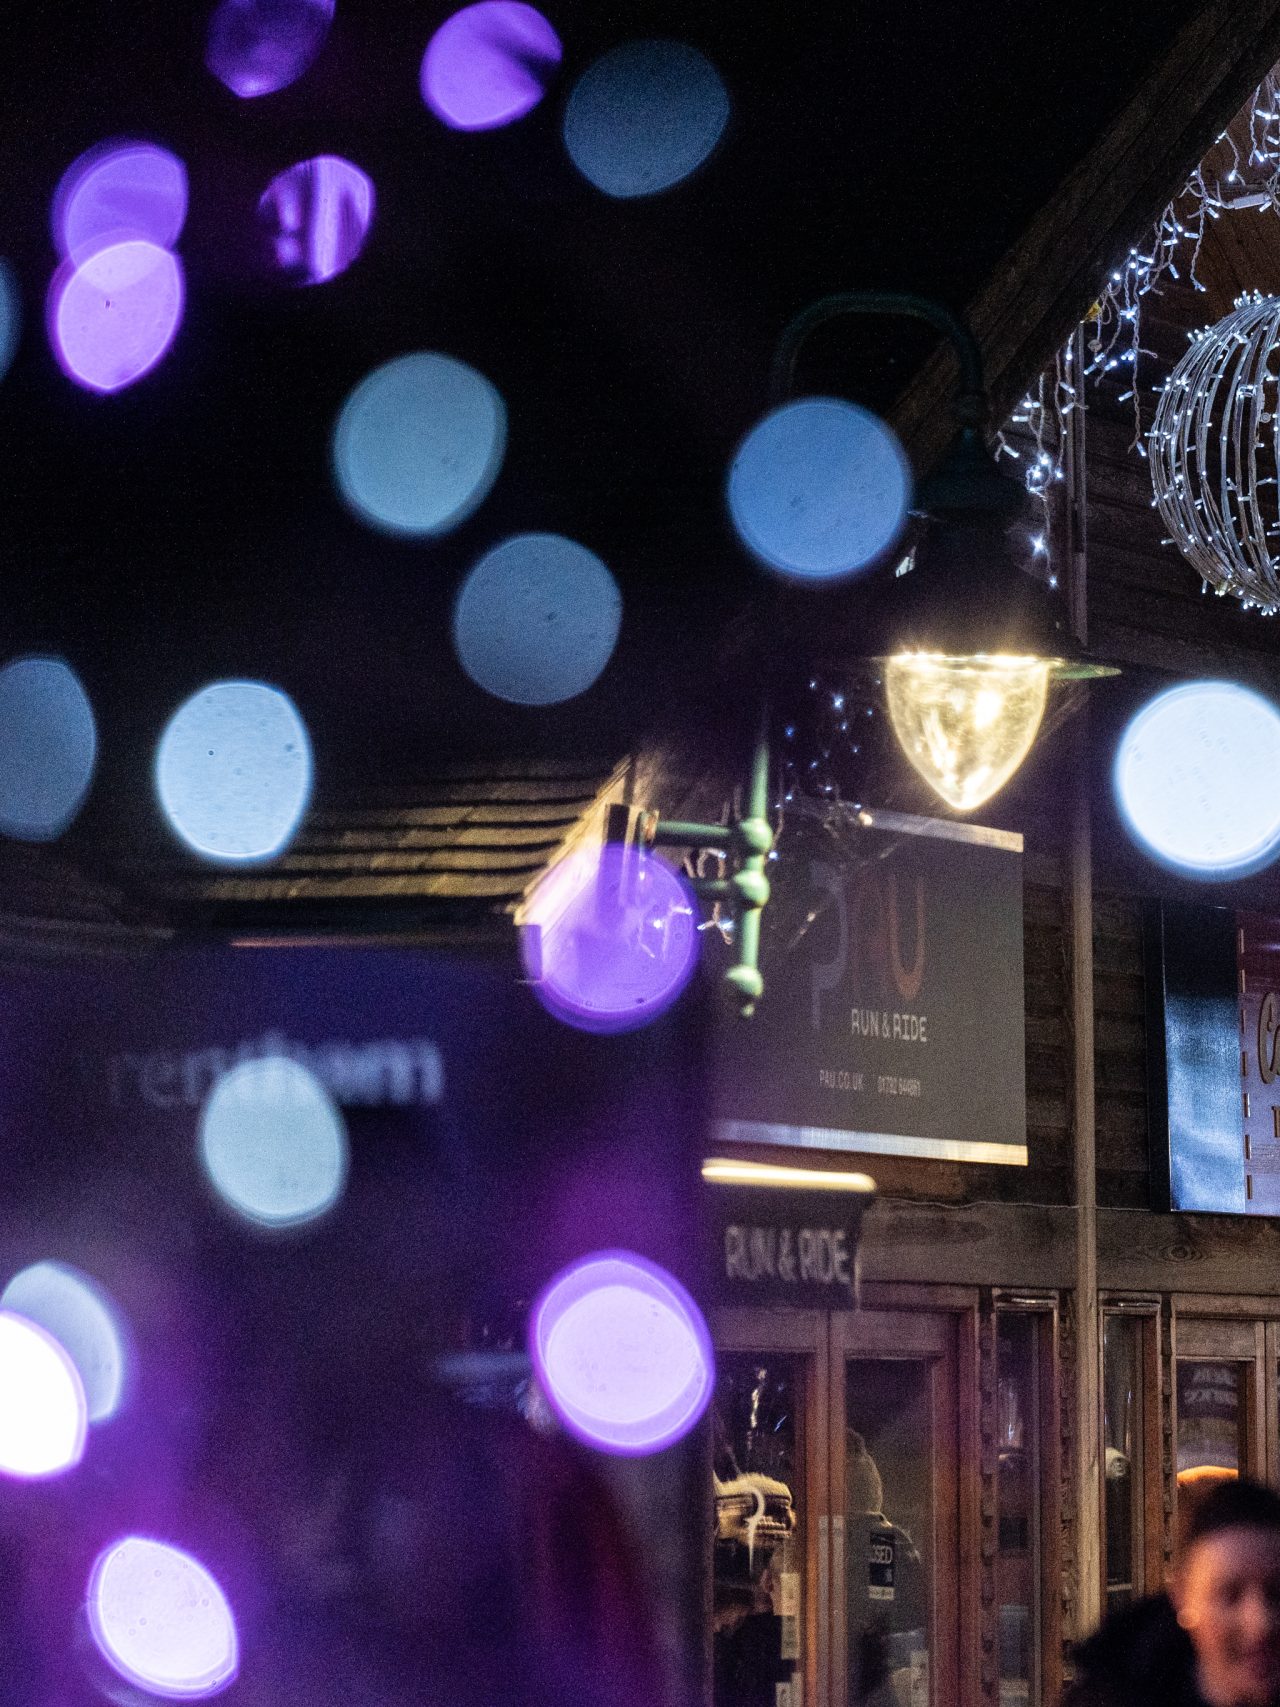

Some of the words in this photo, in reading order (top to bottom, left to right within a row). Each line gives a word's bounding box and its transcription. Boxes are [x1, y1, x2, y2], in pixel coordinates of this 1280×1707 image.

[851, 1008, 879, 1037] RUN
[881, 1011, 891, 1039] &
[893, 1013, 927, 1043] RIDE
[725, 1224, 776, 1280] RUN
[778, 1227, 798, 1282] &
[799, 1227, 850, 1286] RIDE
